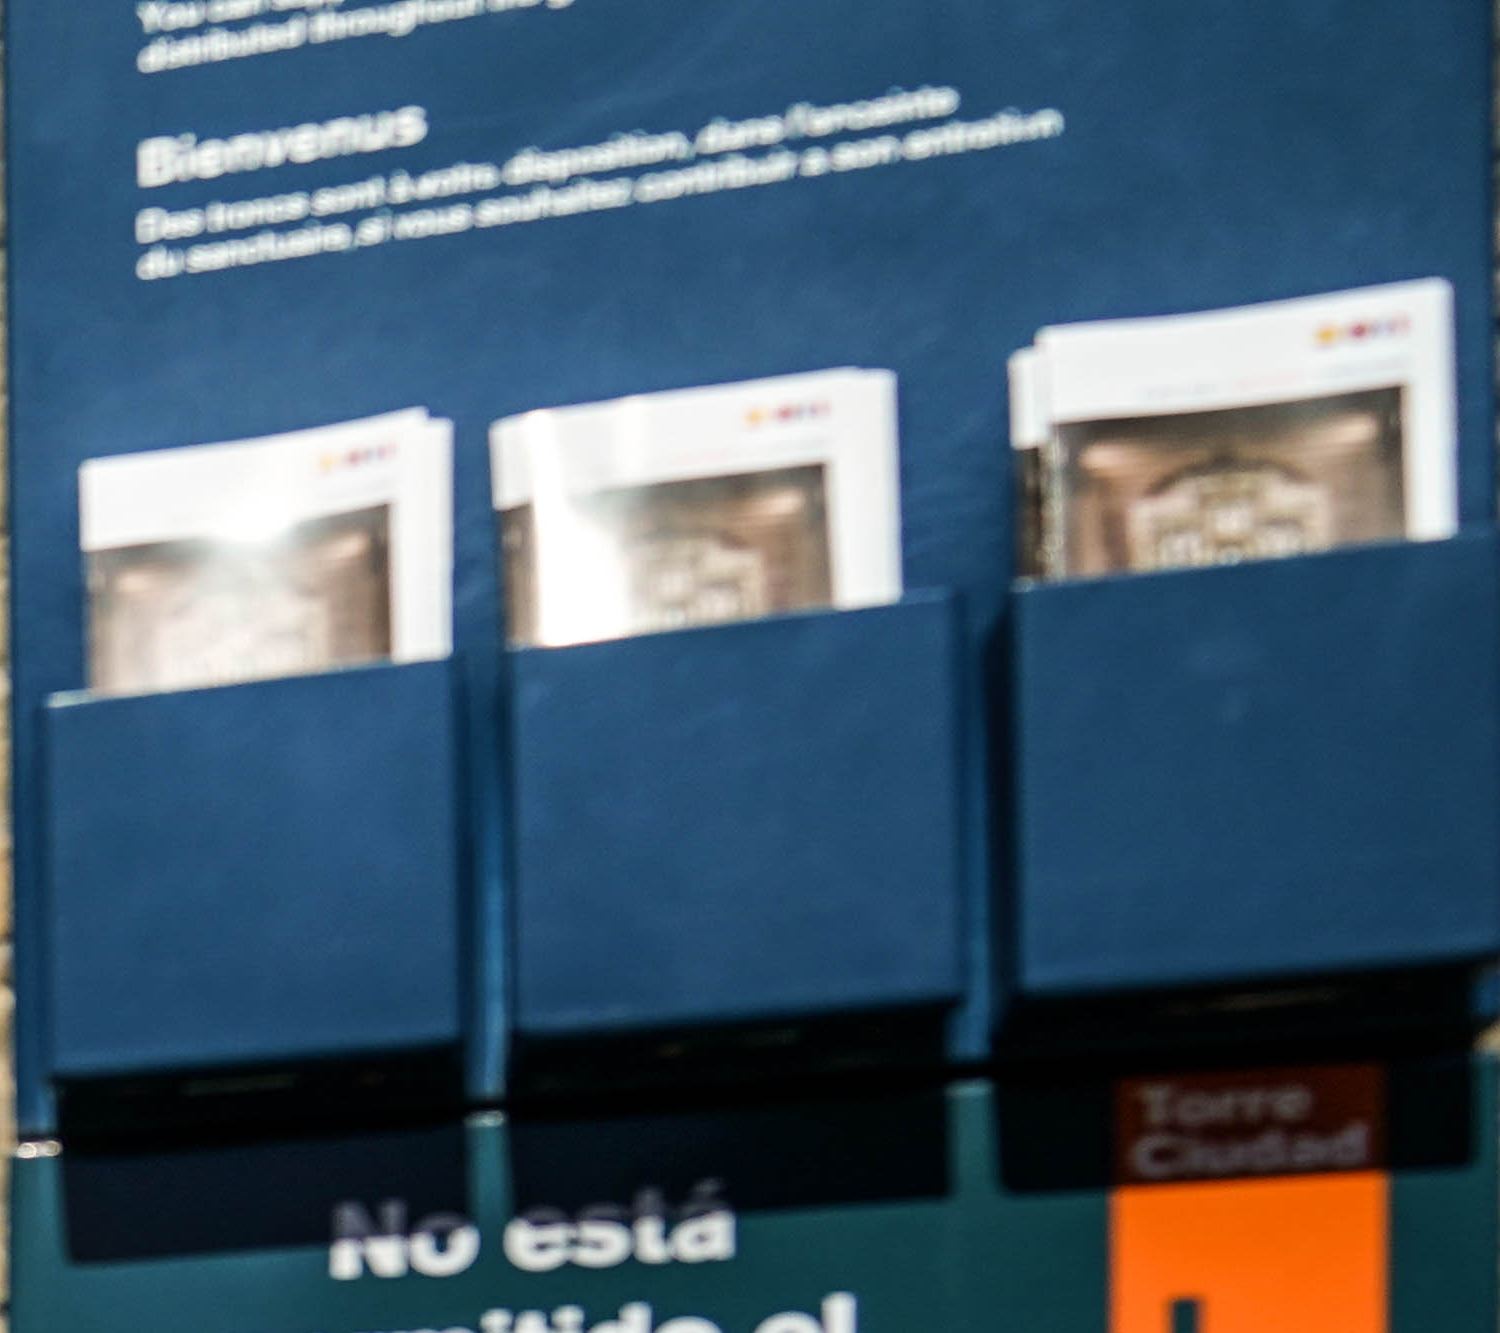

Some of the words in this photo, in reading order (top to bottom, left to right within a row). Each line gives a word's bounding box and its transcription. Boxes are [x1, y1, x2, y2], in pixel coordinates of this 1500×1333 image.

[136, 105, 429, 189] Bienvenus
[1130, 1078, 1314, 1128] Torre
[1127, 1119, 1371, 1179] Ciudad
[329, 1199, 480, 1281] No
[502, 1178, 736, 1272] está
